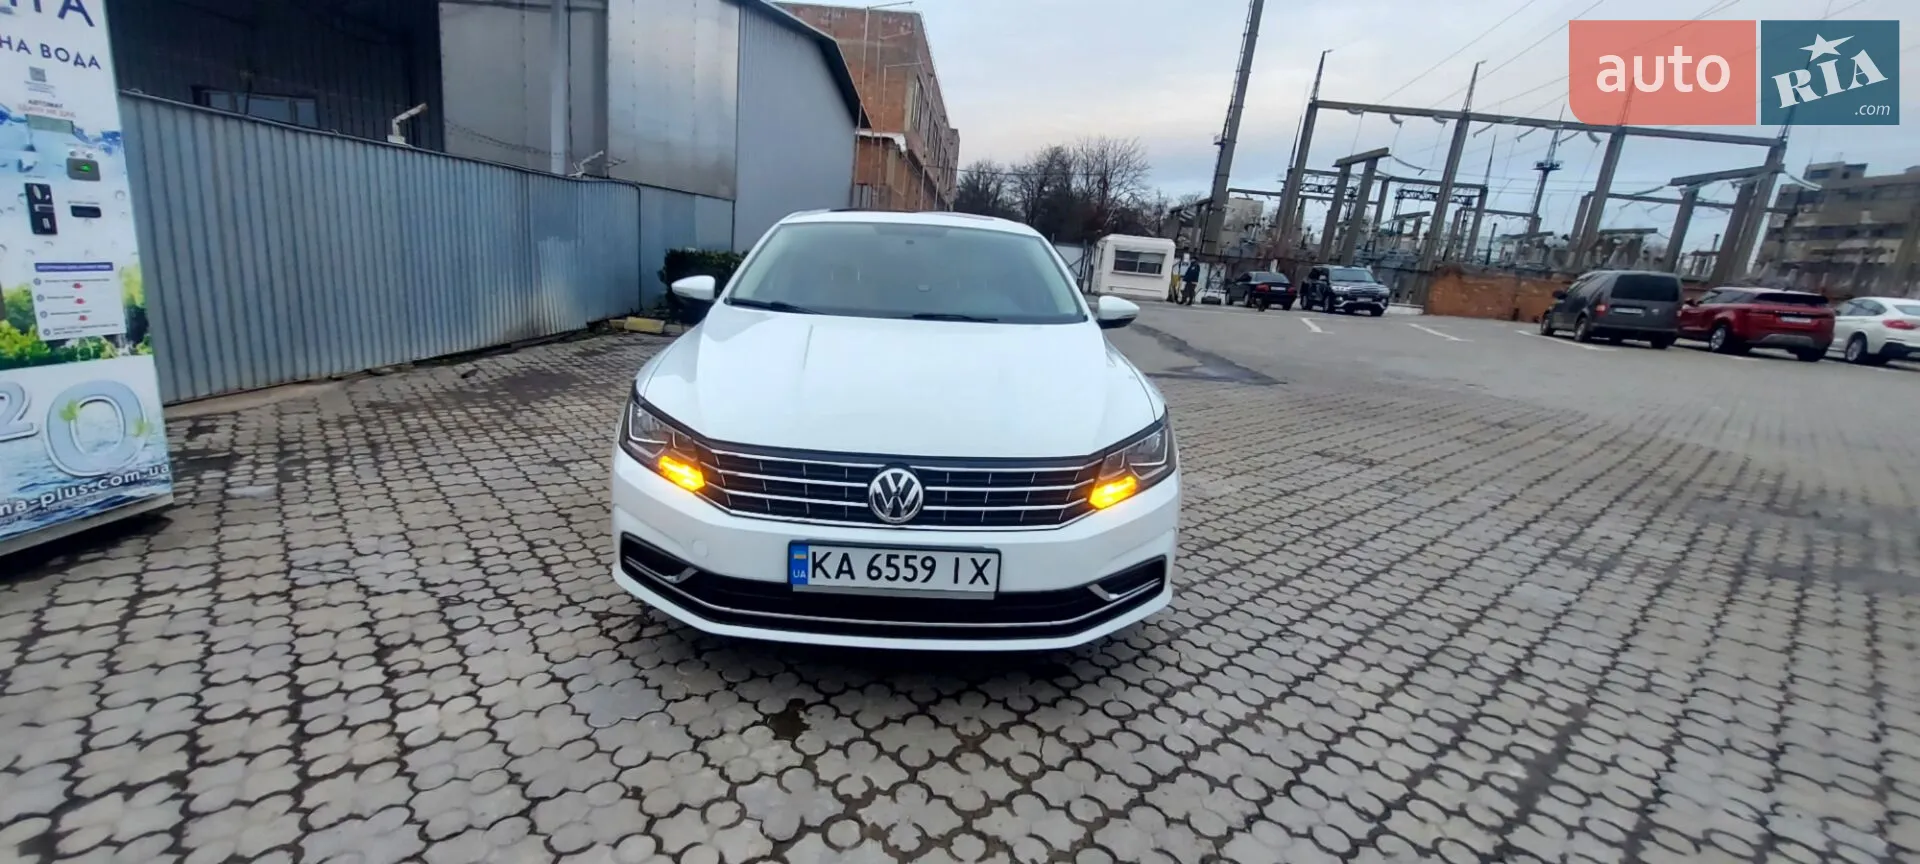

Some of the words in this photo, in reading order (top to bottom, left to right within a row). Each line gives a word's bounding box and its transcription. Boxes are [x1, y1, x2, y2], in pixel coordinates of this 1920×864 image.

[40, 43, 101, 70] ВОДА
[793, 570, 807, 579] UA
[811, 551, 856, 580] KA
[866, 553, 937, 584] 6559
